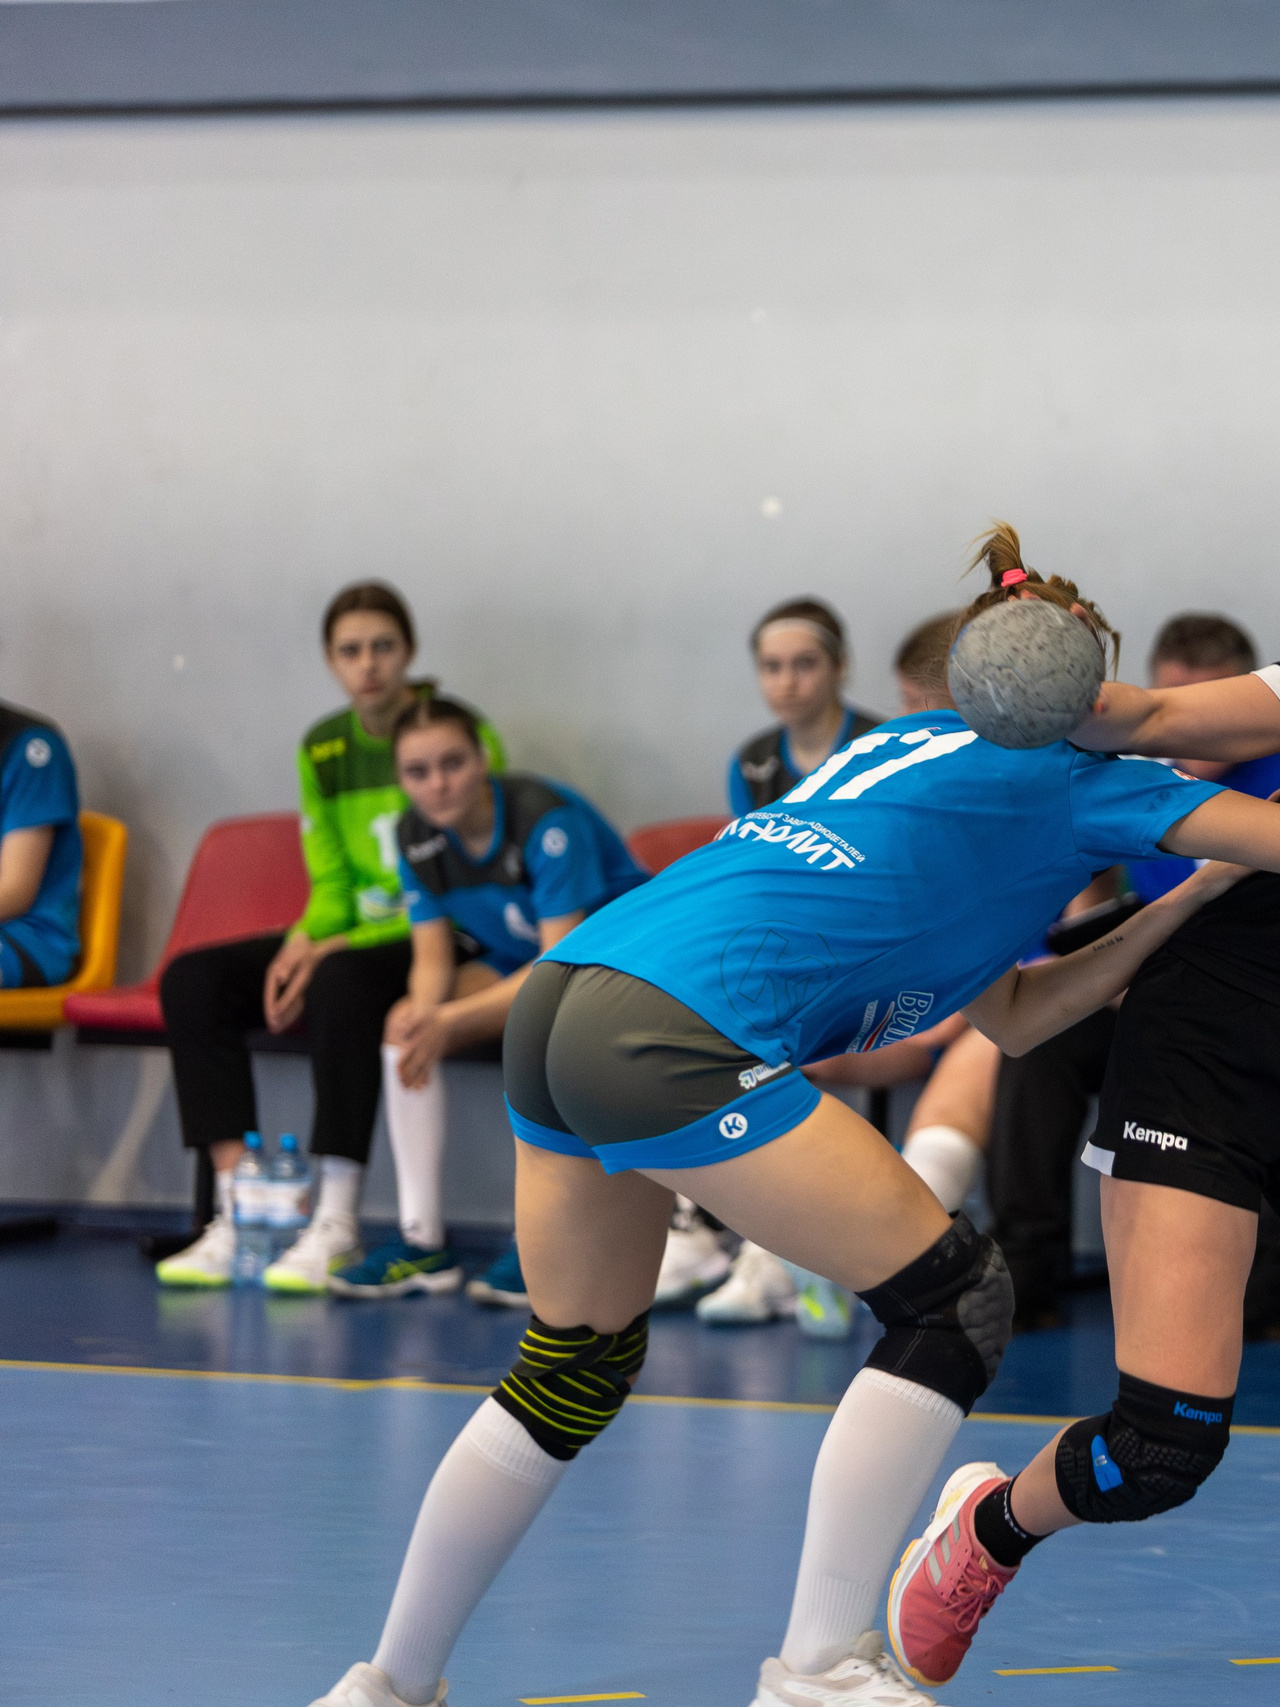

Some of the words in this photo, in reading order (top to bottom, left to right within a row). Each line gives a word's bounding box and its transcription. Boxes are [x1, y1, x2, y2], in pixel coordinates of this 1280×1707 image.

[782, 726, 979, 803] 17
[806, 820, 866, 863] АДИОДЕТАЛЕЙ
[1123, 1120, 1188, 1151] Kempa
[1173, 1400, 1223, 1426] Kempa
